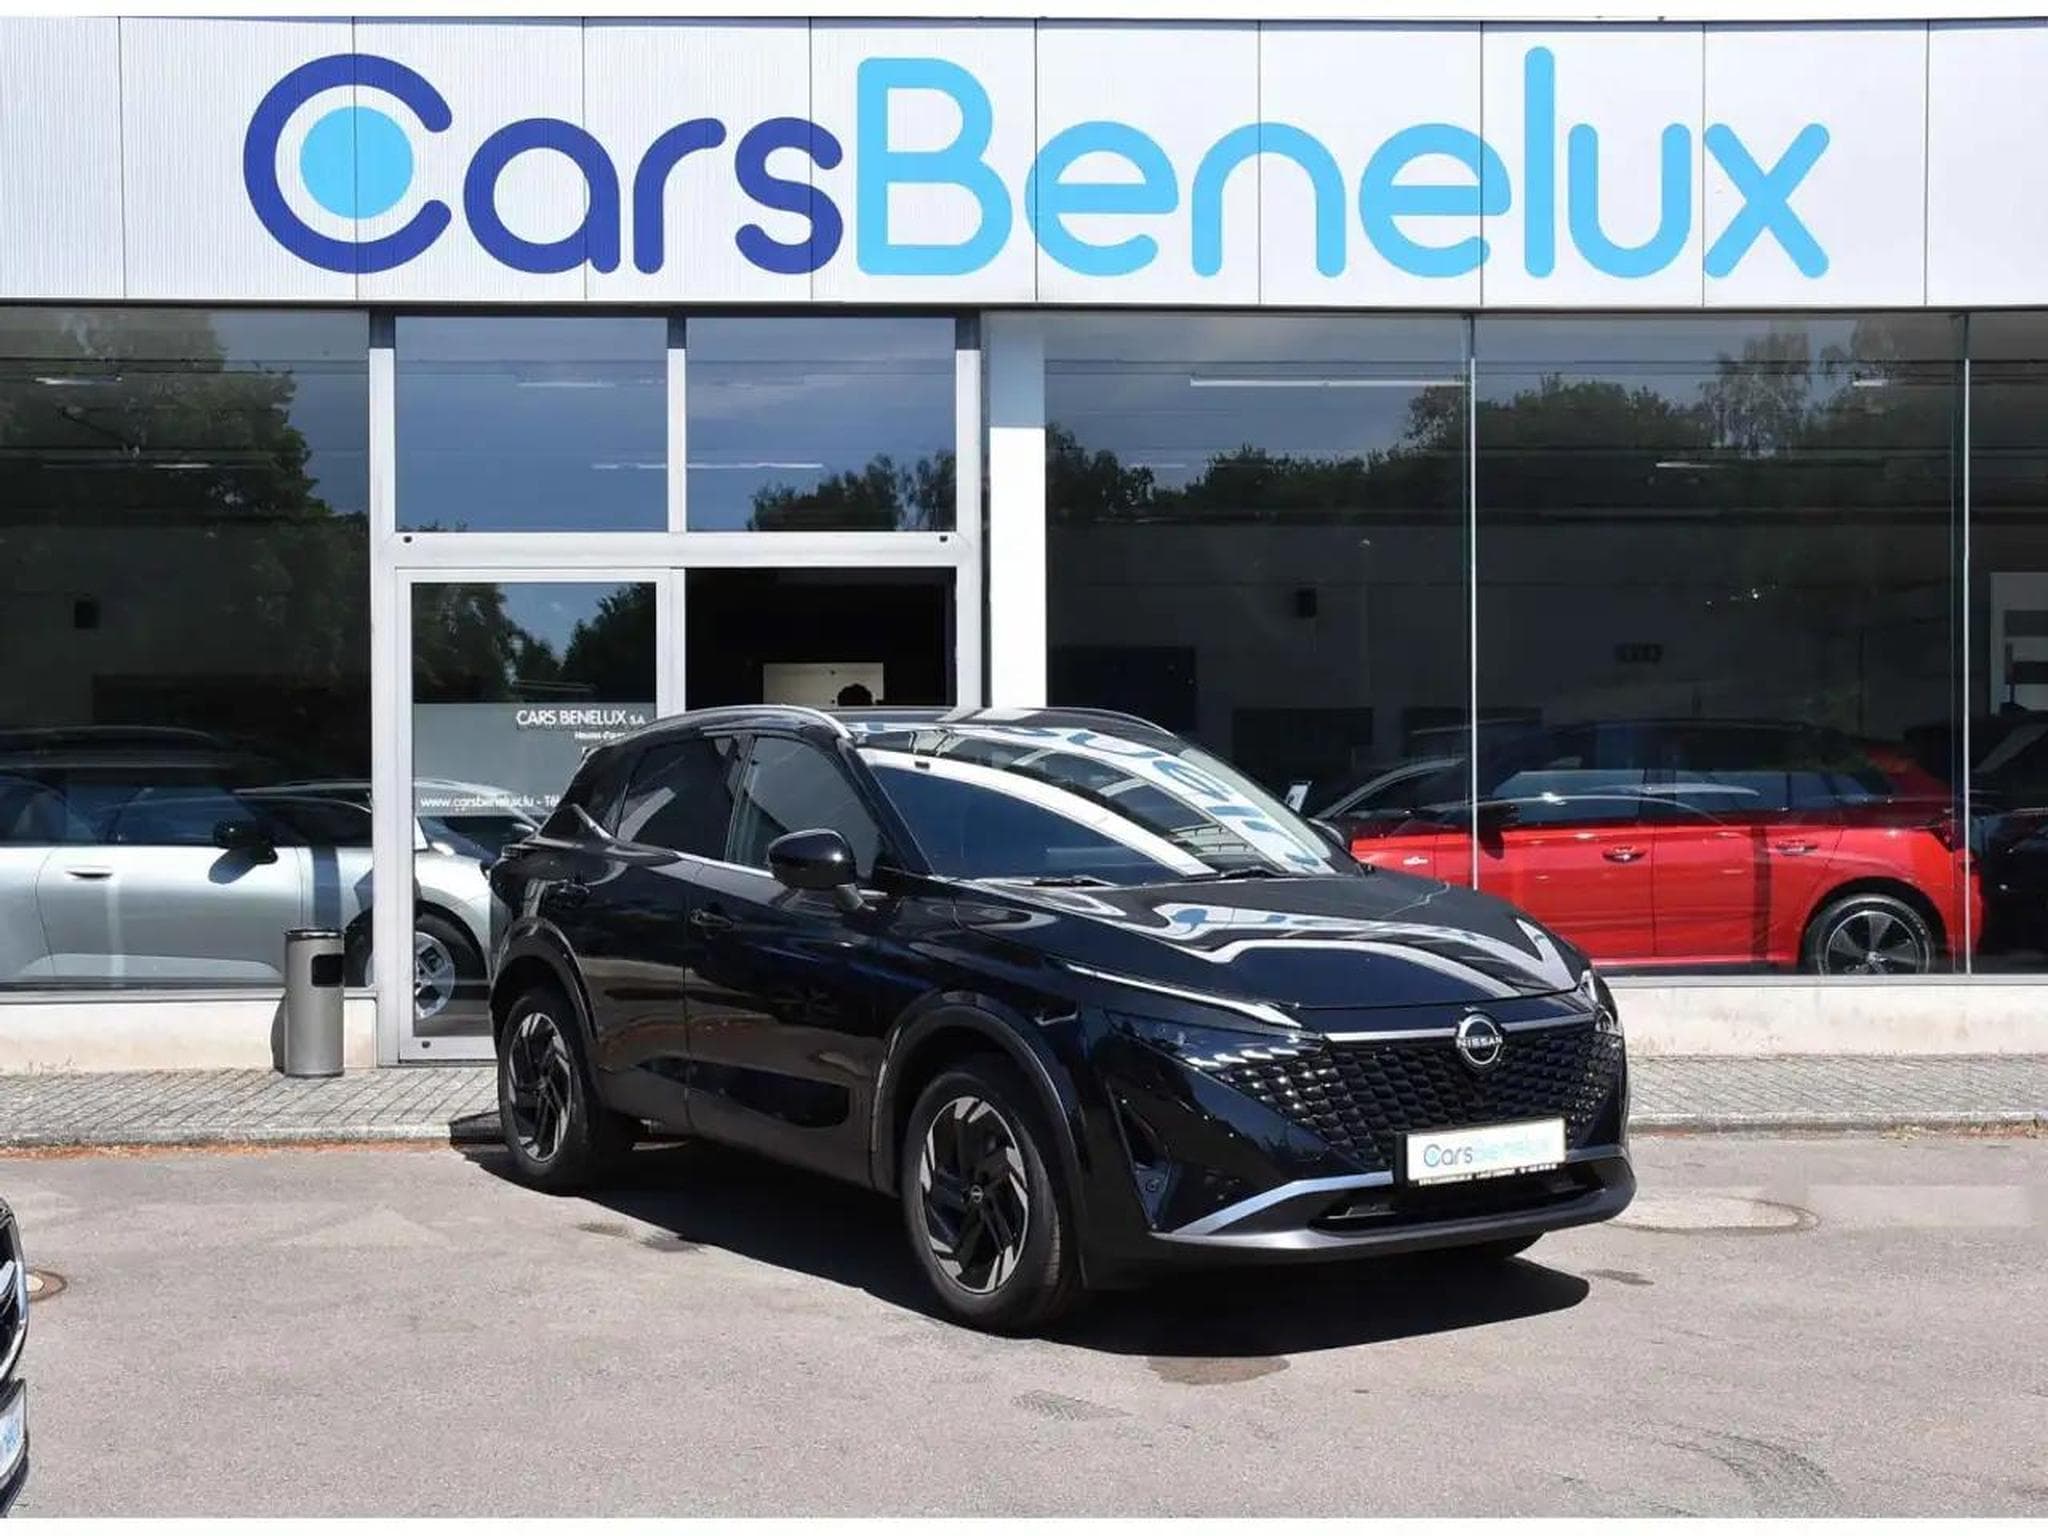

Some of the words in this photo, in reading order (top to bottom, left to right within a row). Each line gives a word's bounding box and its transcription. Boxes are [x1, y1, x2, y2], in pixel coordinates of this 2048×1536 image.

[243, 46, 1832, 280] CarsBenelux
[515, 709, 556, 725] CARS
[559, 709, 627, 725] BENELUX
[1456, 1035, 1503, 1049] NISSAN
